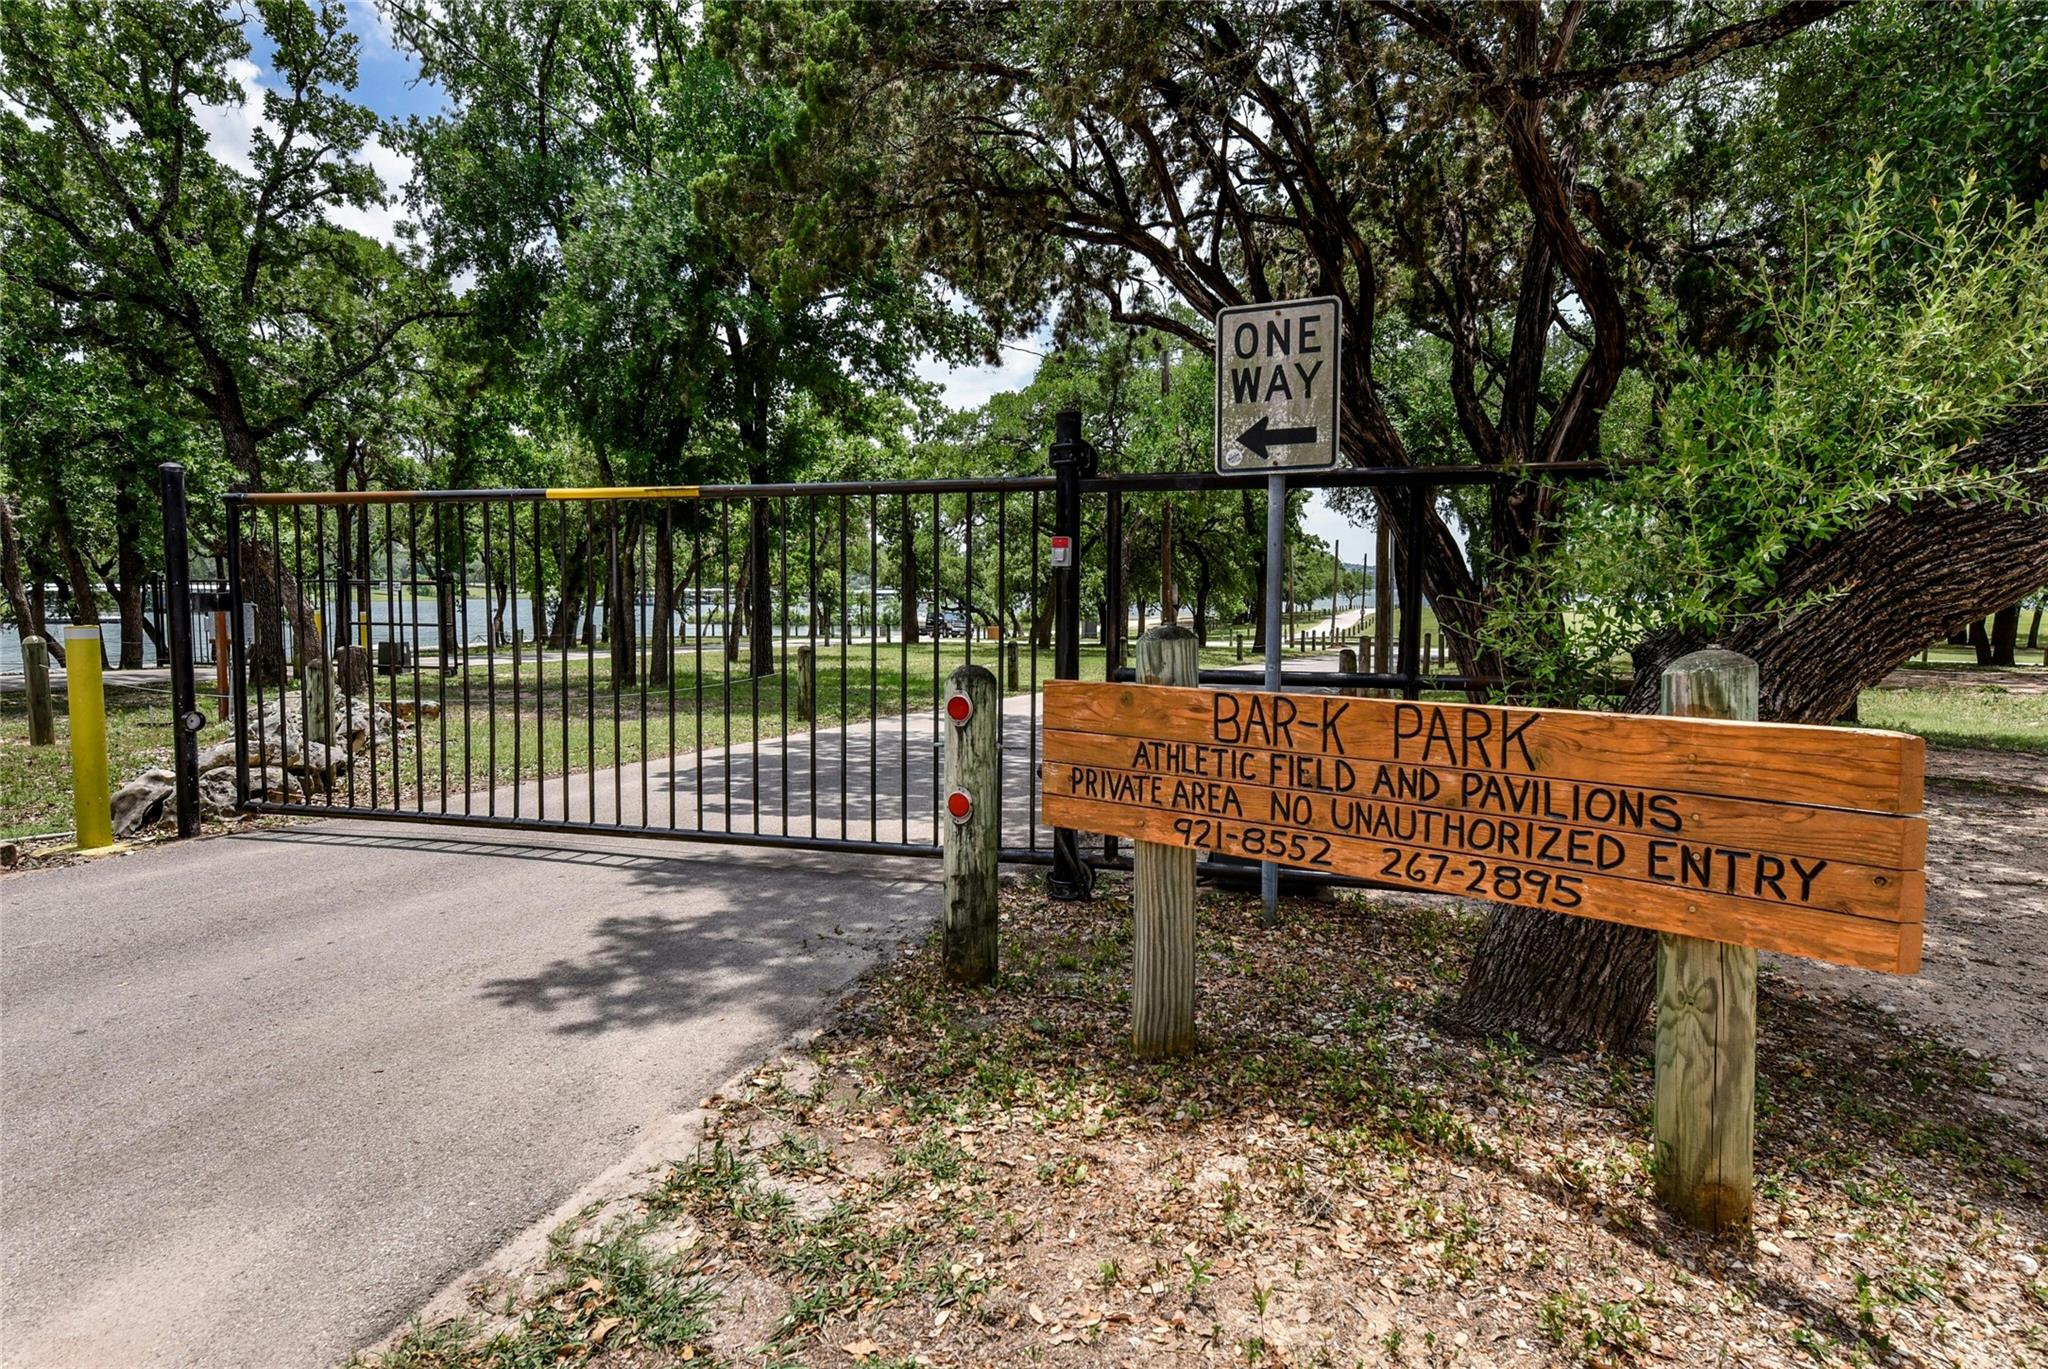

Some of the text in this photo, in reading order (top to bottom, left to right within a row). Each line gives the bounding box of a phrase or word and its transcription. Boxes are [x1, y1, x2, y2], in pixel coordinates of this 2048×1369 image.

[1234, 315, 1321, 360] ONE
[1231, 360, 1323, 404] WAY
[1213, 692, 1541, 771] BAR-K PARK
[1131, 741, 1683, 833] ATHLETIC FIELD AND PAVILIONS
[1071, 766, 1828, 902] PRIVATE AREA NO UNAUTHORIZED ENTRY
[1173, 818, 1583, 909] 921-8552 267-2895
